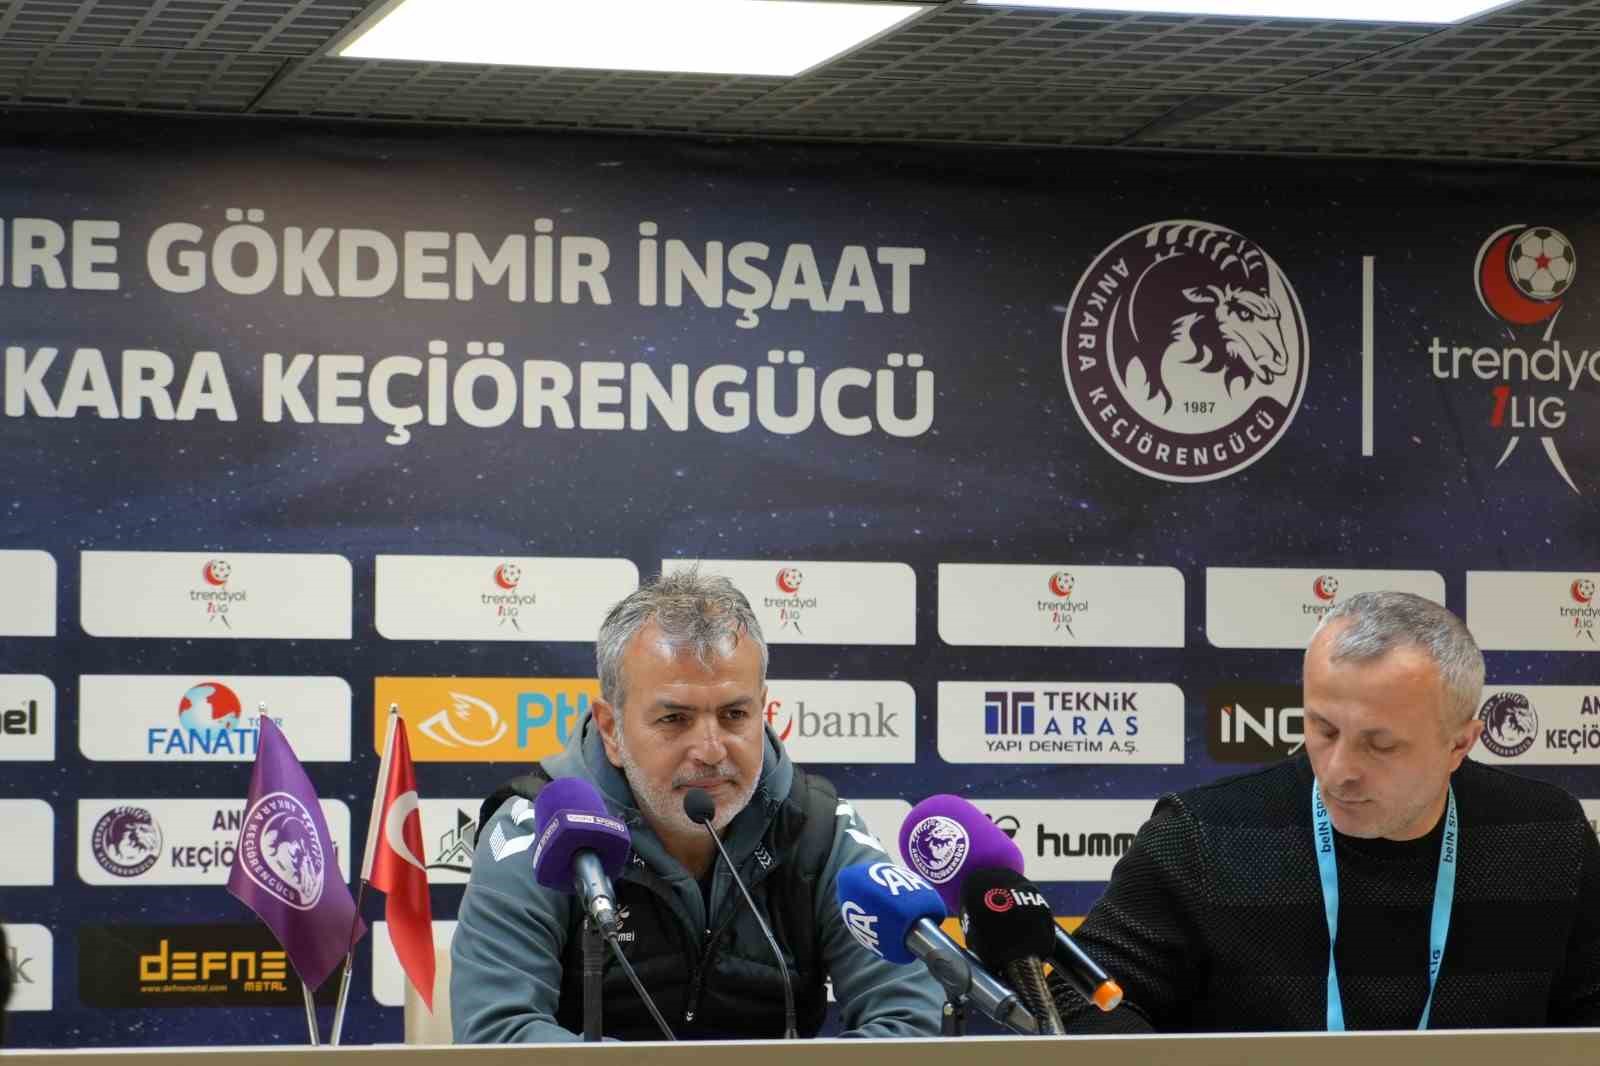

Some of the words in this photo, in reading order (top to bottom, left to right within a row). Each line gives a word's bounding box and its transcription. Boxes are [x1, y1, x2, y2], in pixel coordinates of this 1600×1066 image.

[0, 217, 120, 290] RE
[146, 207, 613, 305] GÖKDEMİR
[638, 221, 926, 329] İNŞAAT
[1078, 257, 1129, 372] ANKARA
[262, 340, 935, 446] KEÇİÖRENGÜCÜ
[1183, 401, 1216, 415] 1987
[1089, 386, 1276, 466] KEÇİÖRENGÜCÜ
[189, 590, 247, 603] trendyol
[481, 594, 537, 606] trendyol
[764, 597, 817, 609] trendyol
[1037, 600, 1089, 613] trendyol
[796, 702, 899, 738] bank
[1043, 716, 1139, 735] ARAS
[986, 741, 1022, 752] YAPI
[1029, 738, 1103, 752] DENETİM
[1109, 741, 1139, 754] A.Ş.
[1318, 821, 1332, 853] beIN
[881, 867, 934, 896] AA
[243, 981, 287, 992] METAL
